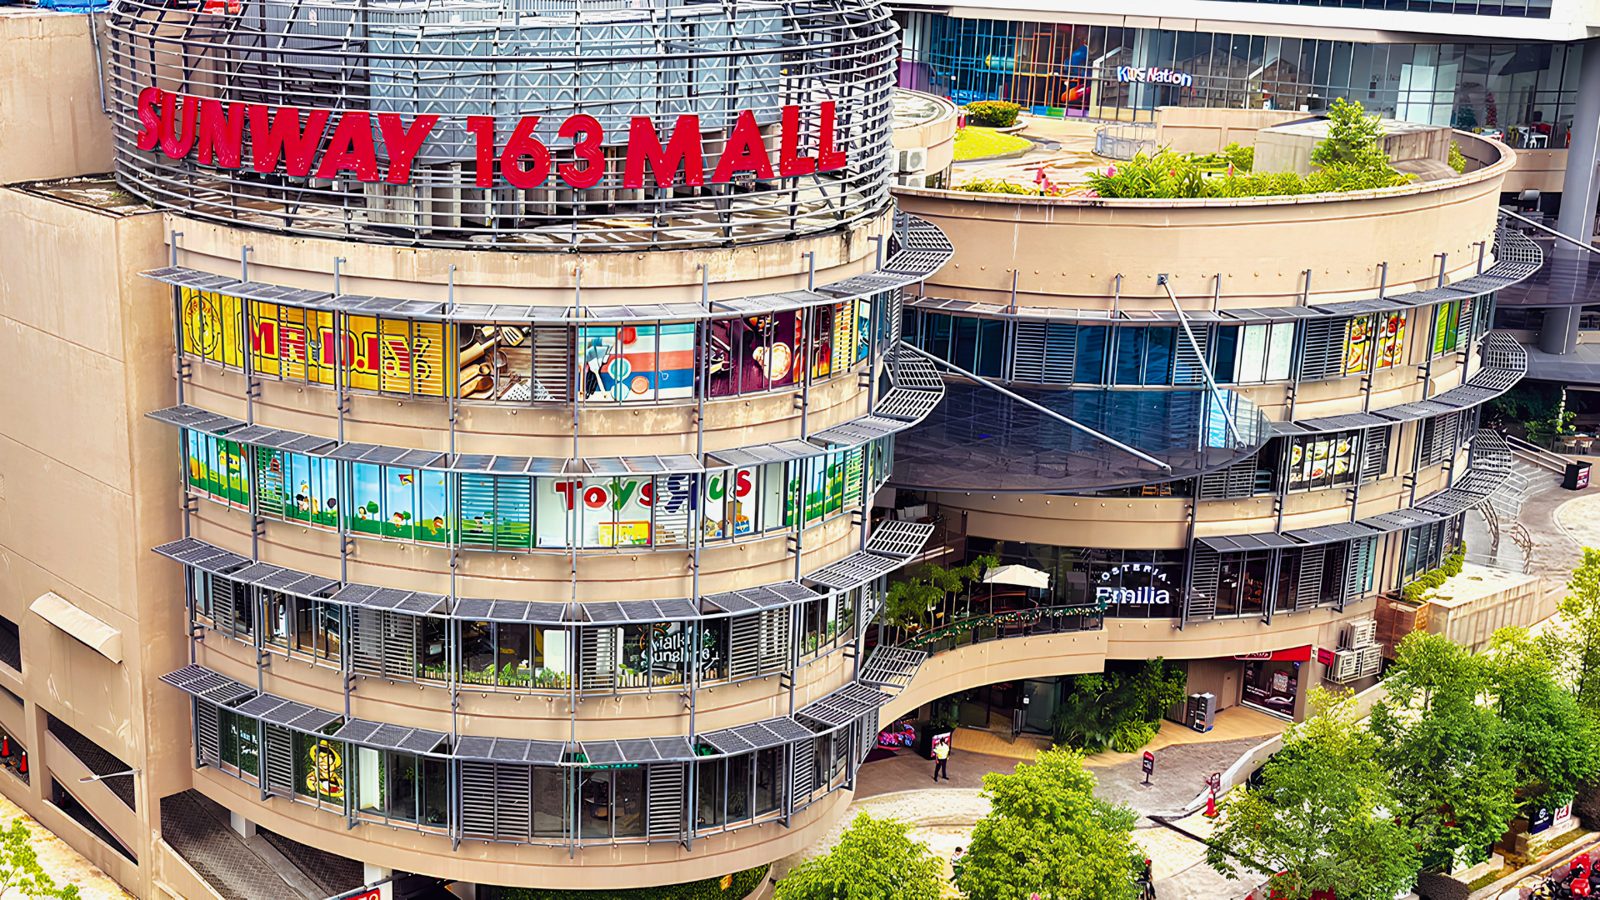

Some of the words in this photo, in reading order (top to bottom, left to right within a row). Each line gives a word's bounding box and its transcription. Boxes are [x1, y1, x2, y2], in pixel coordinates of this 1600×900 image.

[1147, 67, 1191, 86] Nation
[136, 86, 440, 185] SUNWAY
[467, 114, 604, 189] 163
[623, 101, 847, 189] MALL
[1102, 564, 1168, 582] OSTERIA
[1096, 587, 1170, 604] Emilia
